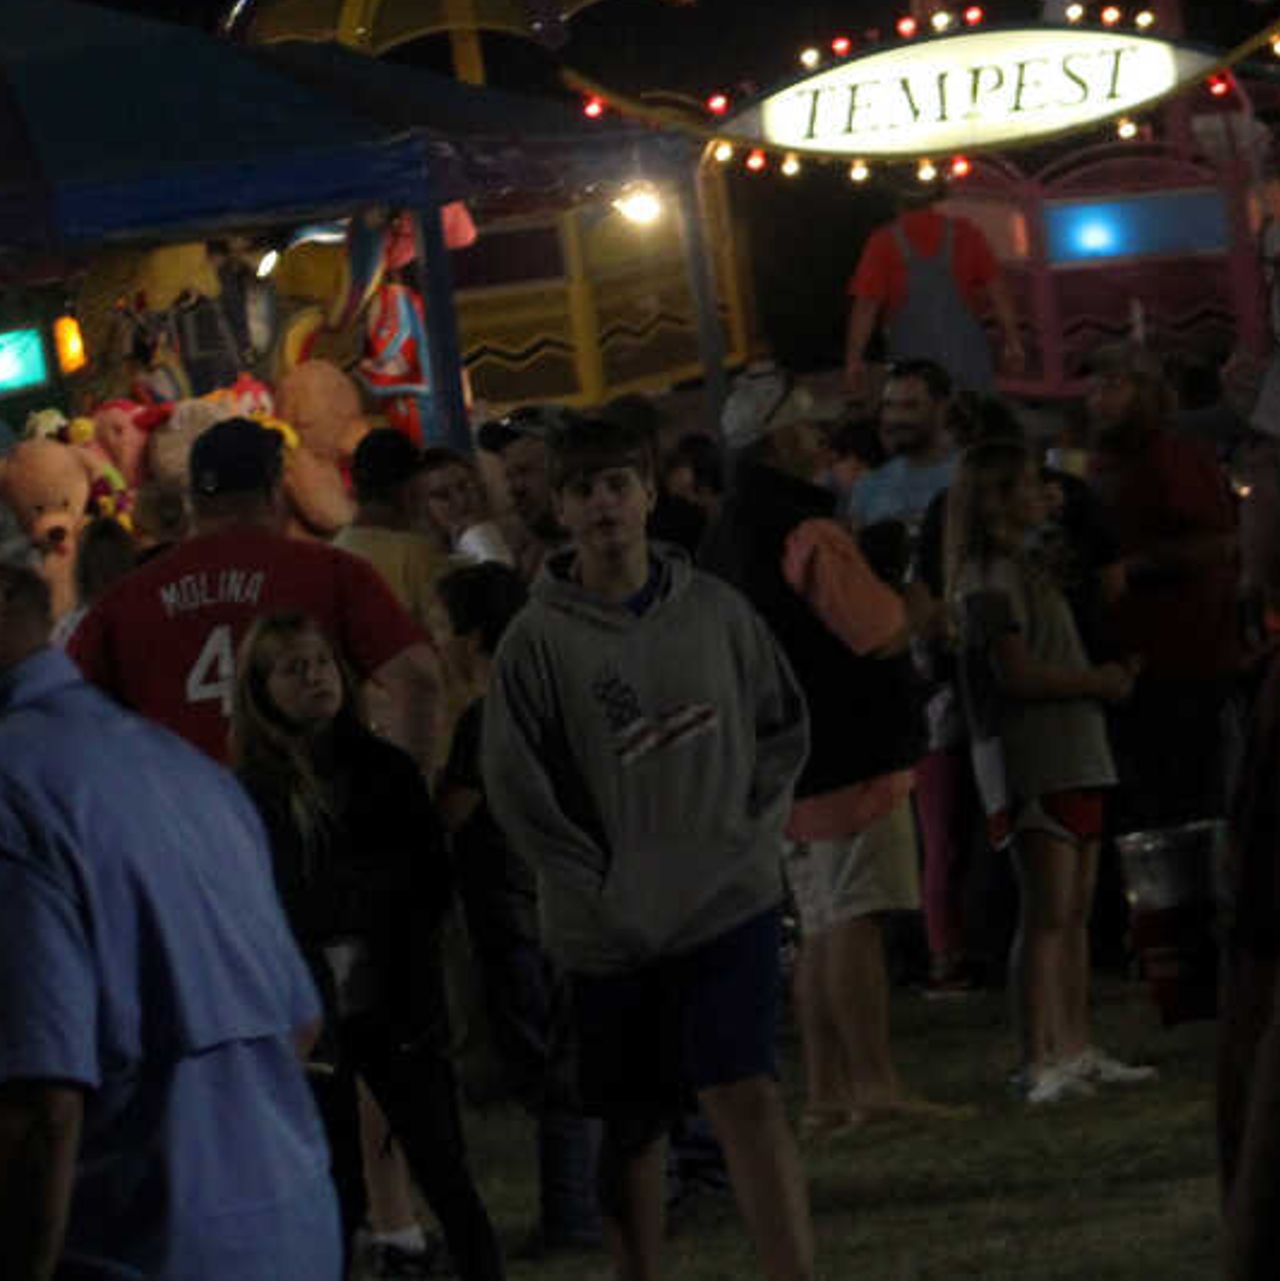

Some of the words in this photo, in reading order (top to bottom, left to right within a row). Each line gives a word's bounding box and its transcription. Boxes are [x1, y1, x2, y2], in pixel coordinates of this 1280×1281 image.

[797, 45, 1138, 140] TEMPEST
[160, 567, 267, 619] MOLINA
[185, 623, 237, 719] 4
